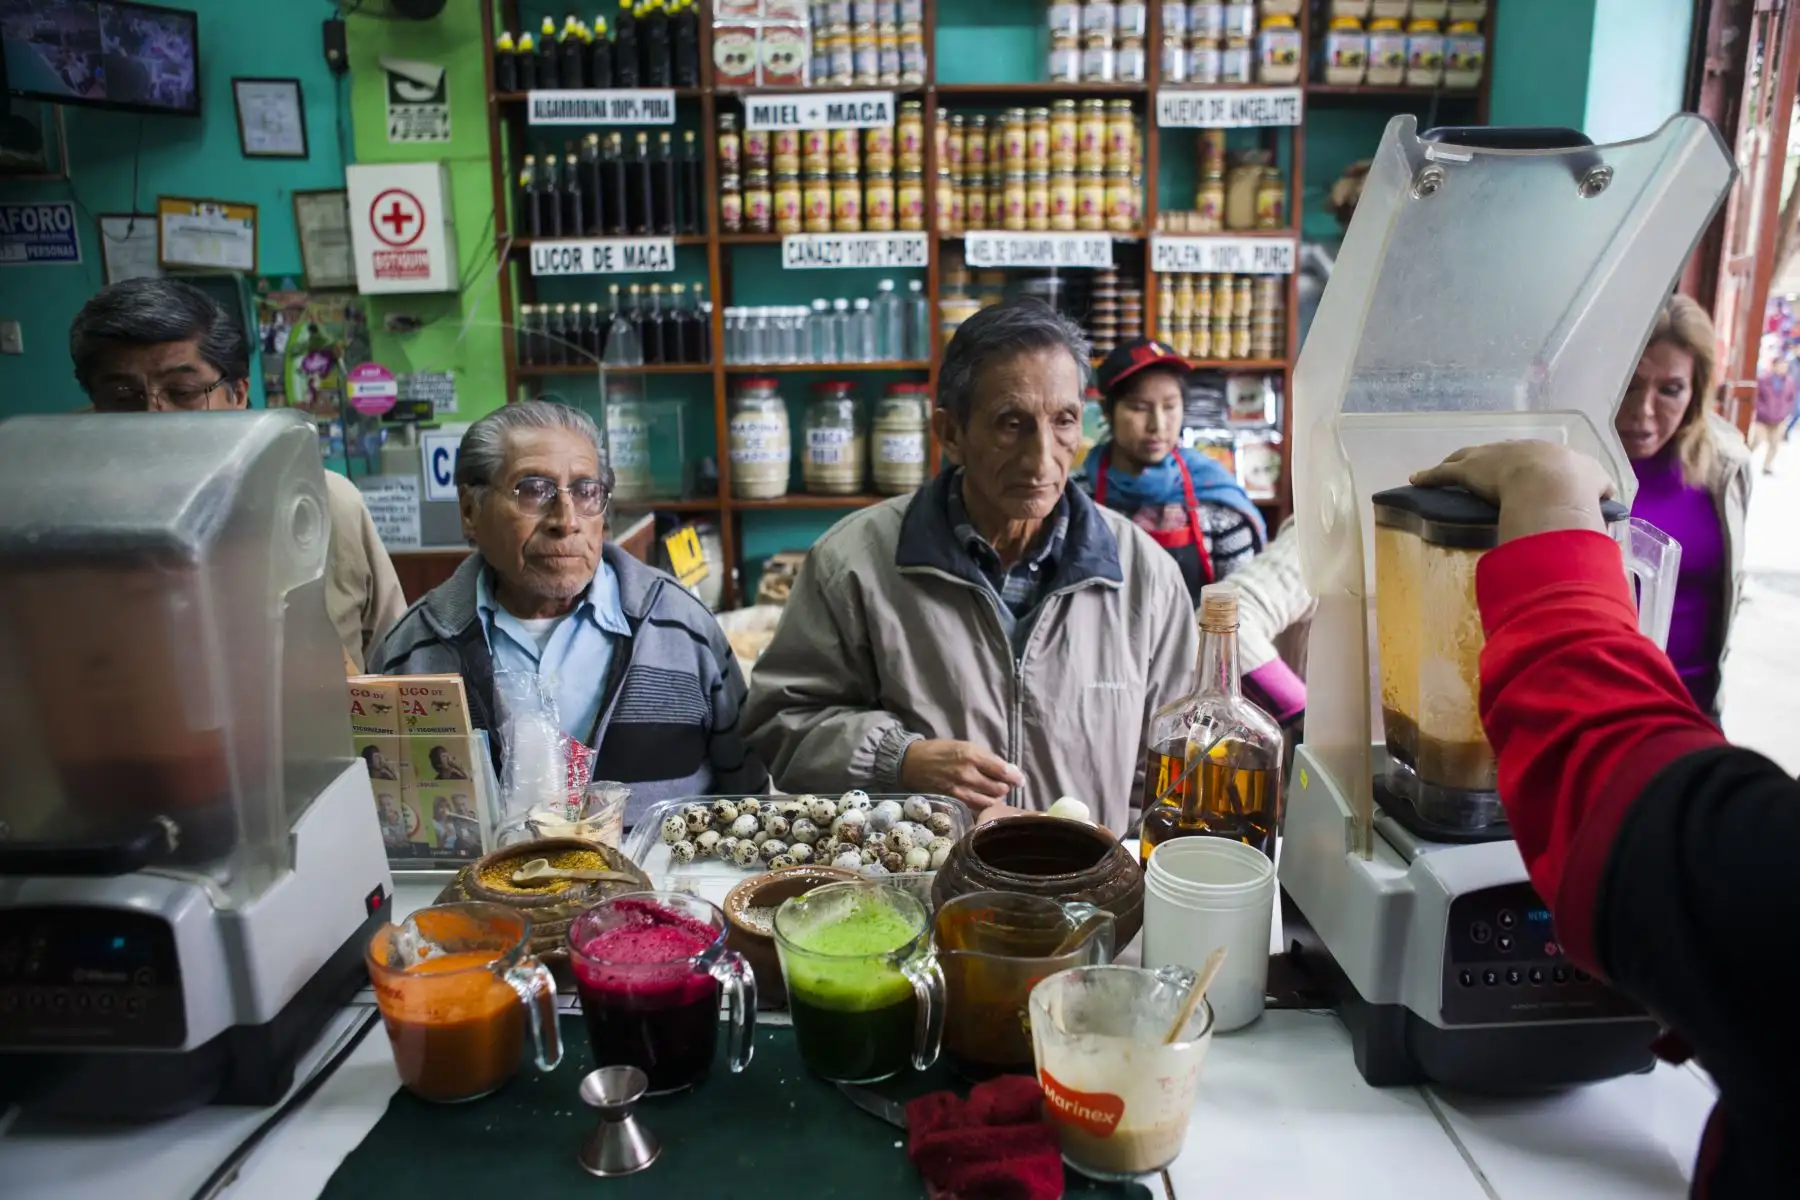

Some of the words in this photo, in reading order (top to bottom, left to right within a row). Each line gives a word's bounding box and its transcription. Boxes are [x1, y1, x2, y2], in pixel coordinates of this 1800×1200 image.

[535, 99, 607, 118] ALGARROBINA
[611, 98, 638, 118] 100%
[643, 98, 669, 118] PURA
[754, 105, 799, 123] MIEL
[827, 102, 887, 122] MACA
[1164, 98, 1203, 121] HUEVO
[1210, 98, 1225, 120] DE
[28, 245, 76, 258] PERSONAS
[535, 246, 582, 271] LICOR
[593, 246, 613, 269] DE
[625, 245, 668, 268] MACA
[848, 240, 881, 264] 100%
[887, 239, 922, 262] PURO
[1158, 245, 1201, 267] POLEN
[1212, 246, 1243, 268] 100%
[1255, 245, 1289, 268] PURO
[399, 687, 429, 696] UGO
[1044, 1084, 1116, 1124] Marinex
